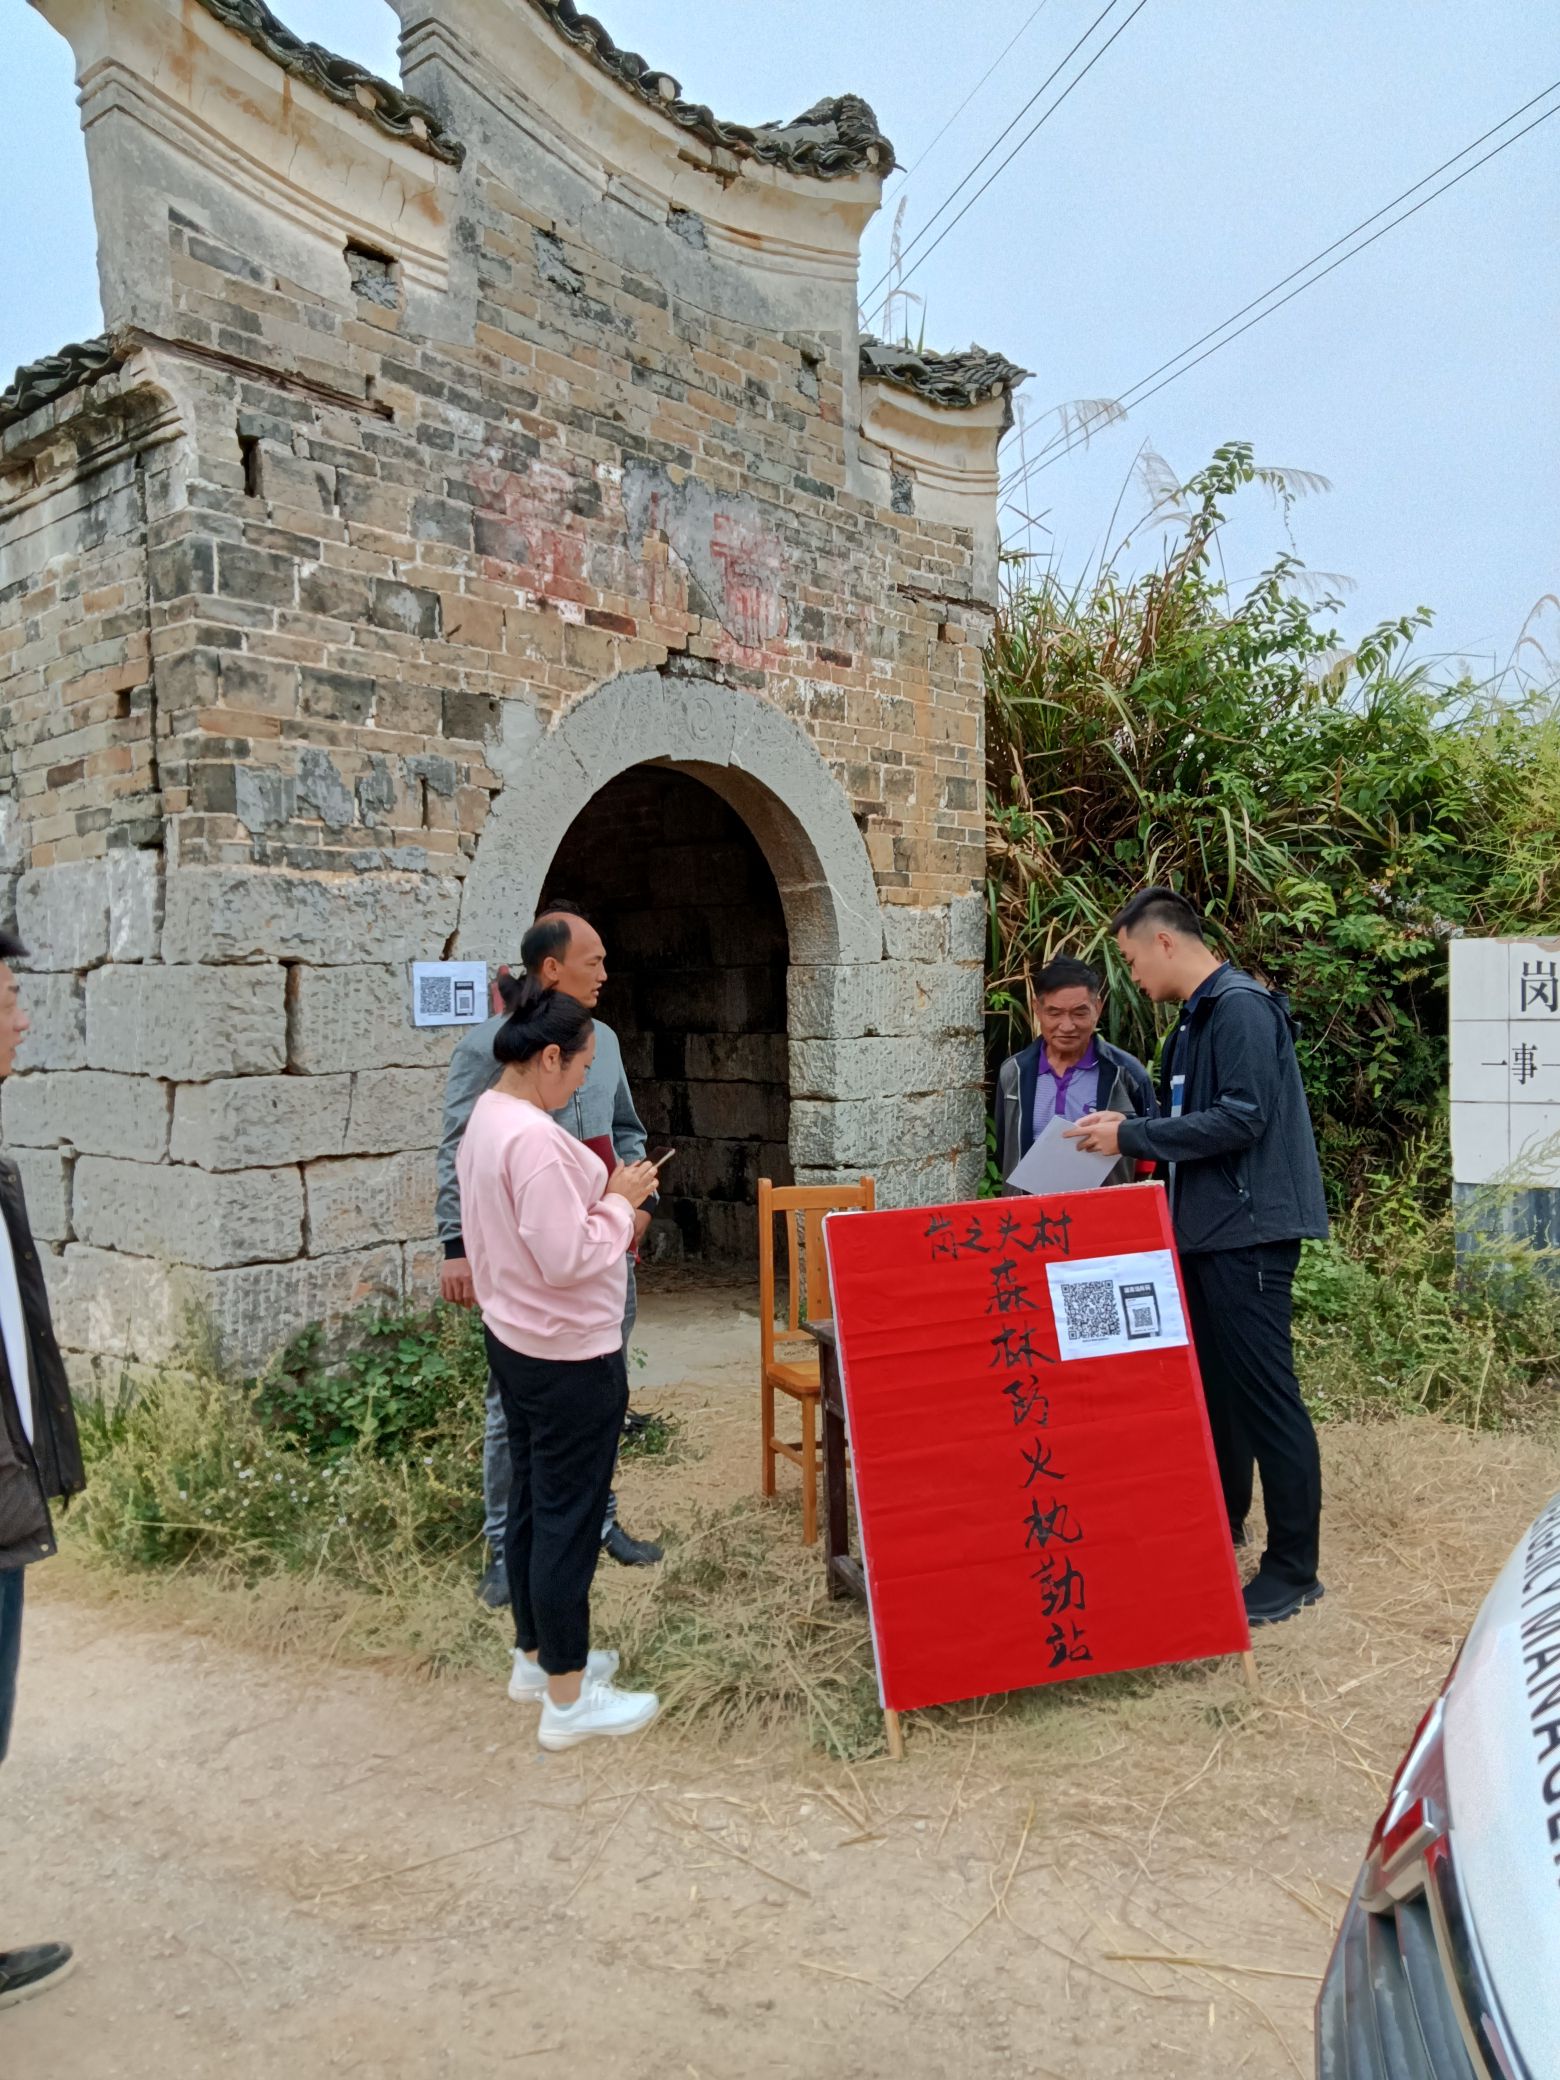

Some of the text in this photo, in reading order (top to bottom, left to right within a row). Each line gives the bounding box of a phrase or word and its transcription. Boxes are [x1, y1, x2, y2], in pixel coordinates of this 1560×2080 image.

[1520, 960, 1559, 1012] 岗
[924, 1207, 1073, 1261] 岗之头村
